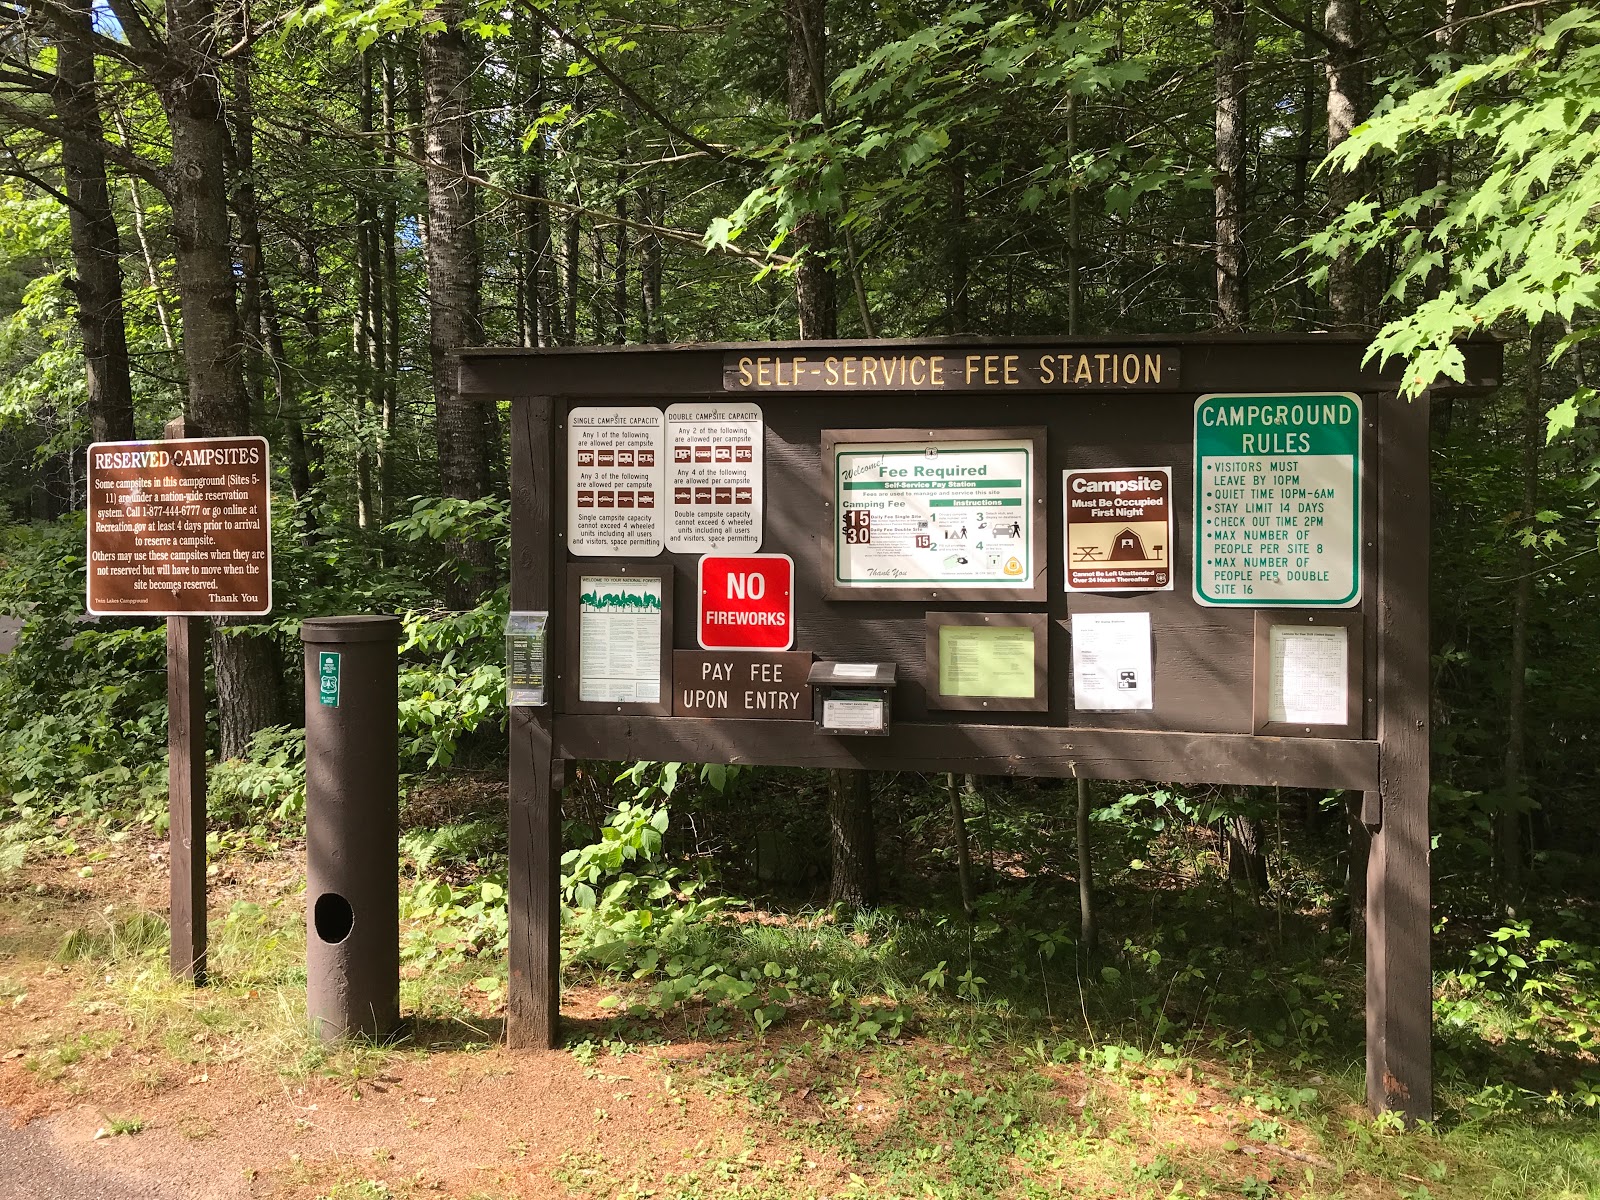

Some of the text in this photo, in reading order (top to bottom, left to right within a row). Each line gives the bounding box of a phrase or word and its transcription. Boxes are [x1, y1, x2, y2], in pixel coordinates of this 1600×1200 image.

[738, 353, 1161, 387] SELF-SERVICE FEE STATION
[1202, 404, 1351, 426] CAMPGROUND
[622, 431, 649, 439] following
[1243, 433, 1310, 453] RULES
[95, 448, 259, 469] RESERVED CAMPSITES
[842, 455, 885, 480] Welcome!
[879, 465, 987, 479] Fee Required
[1215, 462, 1298, 472] VISITORS MUST
[95, 474, 259, 491] Some campsites in this campground (Sites 5-
[1215, 475, 1299, 485] LEAVE BY 10PM
[1072, 476, 1162, 495] Campsite
[105, 493, 116, 504] 11)
[161, 492, 203, 503] nation-wide
[205, 490, 248, 500] reservation
[1215, 489, 1334, 499] QUIET TIME 10PM-6AM
[843, 501, 884, 509] Camping
[1099, 499, 1112, 507] Be
[1114, 497, 1163, 506] Occupied
[98, 505, 257, 519] system. Call 1-877-444-6777 or go online at
[1092, 508, 1143, 517] First Night
[1215, 503, 1324, 513] STAY LIMIT 14 DAYS
[930, 513, 936, 522] 1
[977, 513, 984, 521] 3
[1215, 517, 1323, 527] CHECK OUT TIME 2PM
[96, 519, 260, 534] Recreation.gov at least 4 days prior to arrival
[1215, 530, 1310, 540] MAX NUMBER OF
[135, 537, 142, 545] to
[179, 535, 215, 548] campsite.
[930, 542, 937, 551] 2
[976, 542, 983, 550] 4
[1215, 544, 1323, 554] PEOPLE PER SITE 8
[92, 549, 264, 563] Others may use these campsites when they are
[1215, 558, 1309, 567] MAX NUMBER OF
[97, 564, 259, 575] not reserved but will have to move when the
[867, 568, 907, 577] Thank You
[1215, 571, 1329, 581] PEOPLE PER DOUBLE
[134, 579, 218, 590] site becomes reserved.
[727, 572, 765, 600] NO
[1215, 585, 1253, 594] SITE 16
[209, 593, 258, 603] Thank You
[706, 611, 785, 626] FIREWORKS
[702, 663, 783, 682] PAY FEE
[684, 690, 800, 710] UPON ENTRY
